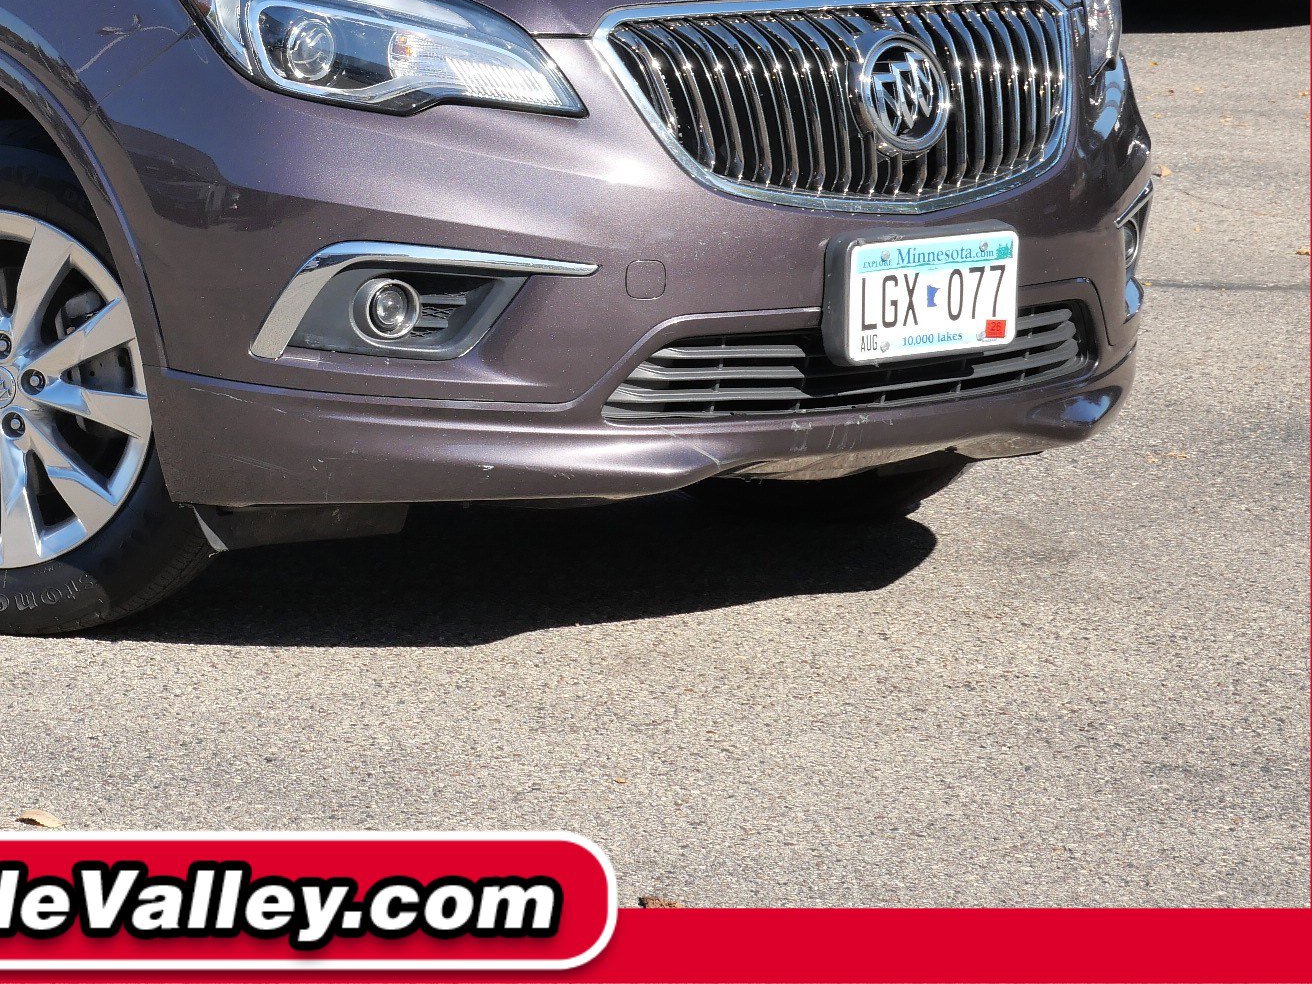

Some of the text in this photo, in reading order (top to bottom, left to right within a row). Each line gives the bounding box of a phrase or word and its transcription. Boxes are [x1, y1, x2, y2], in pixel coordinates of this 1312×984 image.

[896, 246, 994, 266] Minnesota.com
[861, 264, 1006, 331] LGX 077
[860, 332, 963, 352] AUG 10,000 lakes
